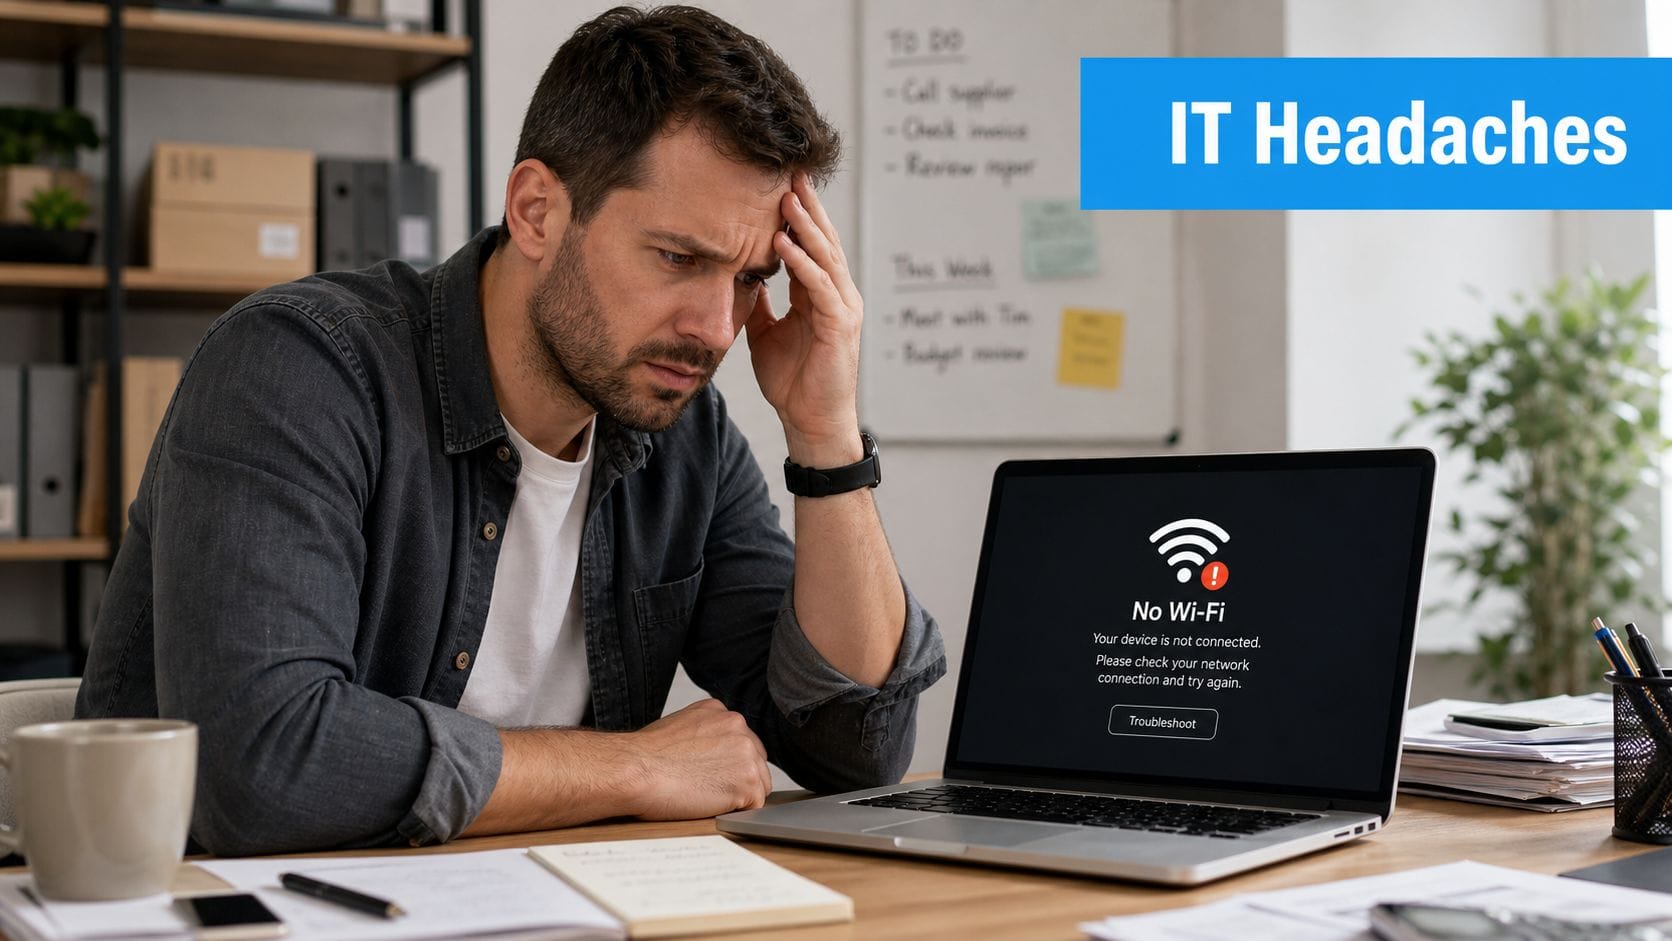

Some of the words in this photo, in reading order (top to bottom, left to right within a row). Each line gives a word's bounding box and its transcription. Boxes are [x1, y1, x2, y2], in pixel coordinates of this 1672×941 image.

[1132, 601, 1163, 622] No
[1169, 601, 1226, 623] Wi-Fi
[1093, 632, 1119, 645] Your
[1120, 633, 1158, 646] device
[1160, 634, 1170, 646] is
[1173, 635, 1193, 647] not
[1195, 636, 1262, 649] connected.
[1096, 654, 1133, 667] Please
[1134, 655, 1169, 668] check
[1171, 658, 1198, 671] your
[1201, 659, 1251, 672] network
[1097, 673, 1160, 686] connection
[1162, 675, 1185, 687] and
[1188, 676, 1205, 690] try
[1206, 676, 1243, 691] again.
[1129, 715, 1197, 730] Troubleshoot
